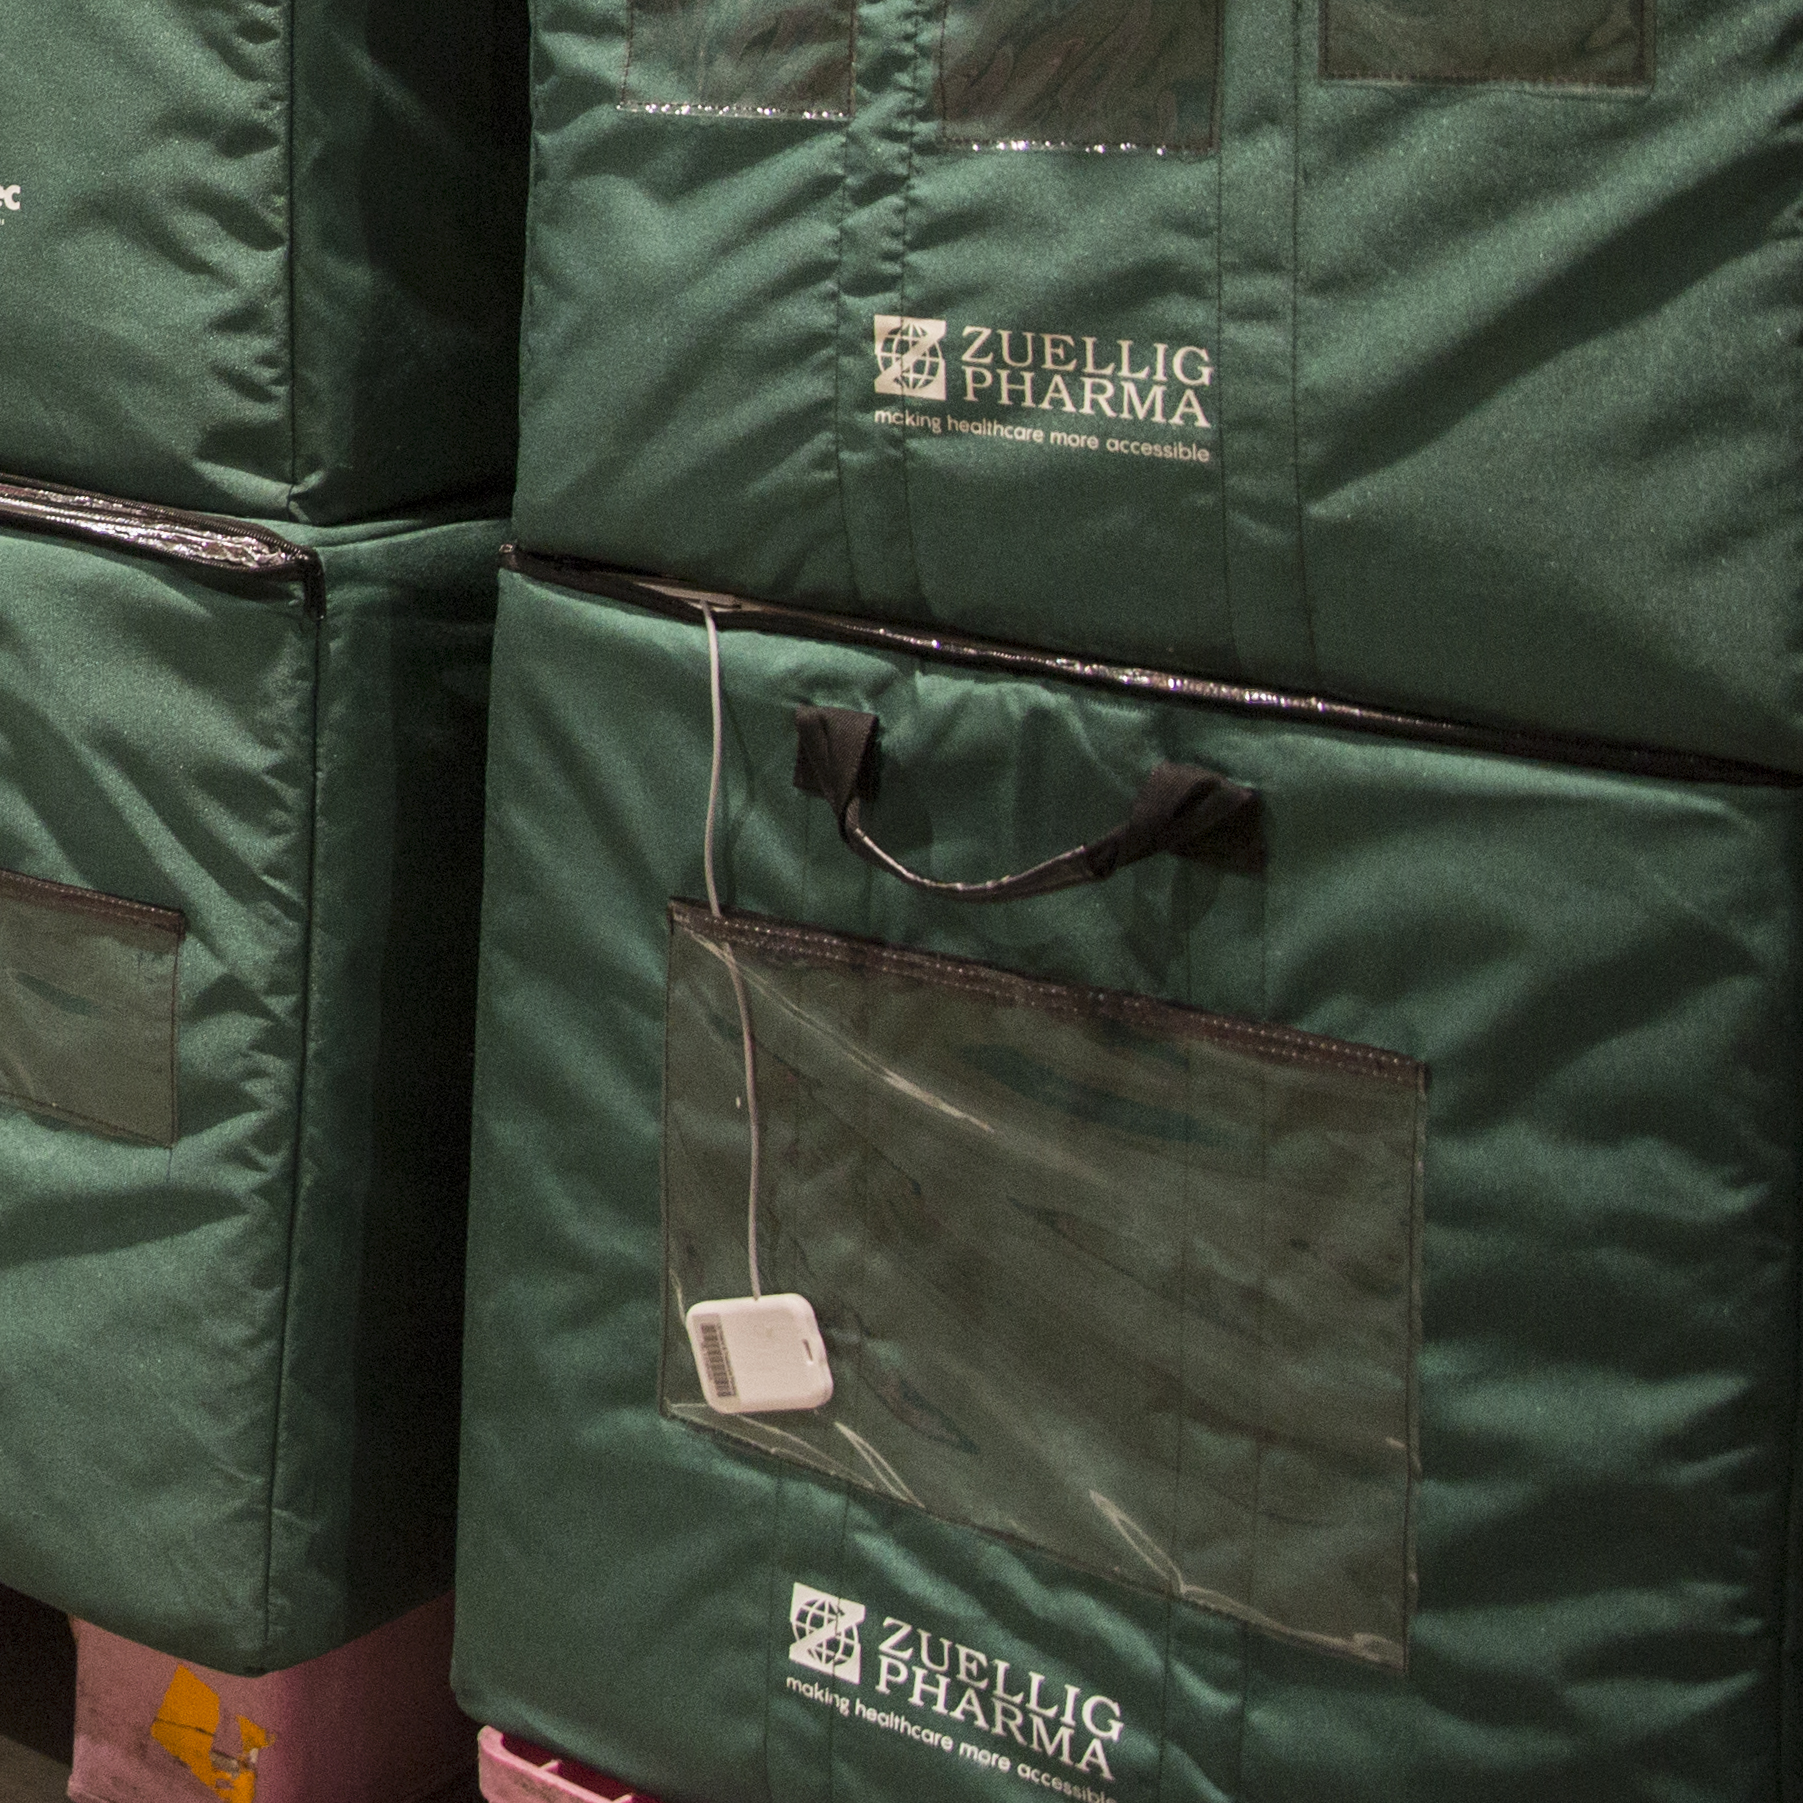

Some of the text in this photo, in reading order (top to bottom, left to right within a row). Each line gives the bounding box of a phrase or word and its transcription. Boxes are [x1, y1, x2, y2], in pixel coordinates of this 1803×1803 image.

[960, 325, 1214, 387] ZUELLIG
[873, 408, 1210, 463] making healthcare more accessible
[962, 365, 1211, 428] PHARMA
[875, 1654, 1115, 1781] PHARMA
[878, 1615, 1125, 1742] ZUELLIG
[786, 1675, 850, 1717] making
[855, 1698, 954, 1751] healthcare
[959, 1742, 1012, 1772] more
